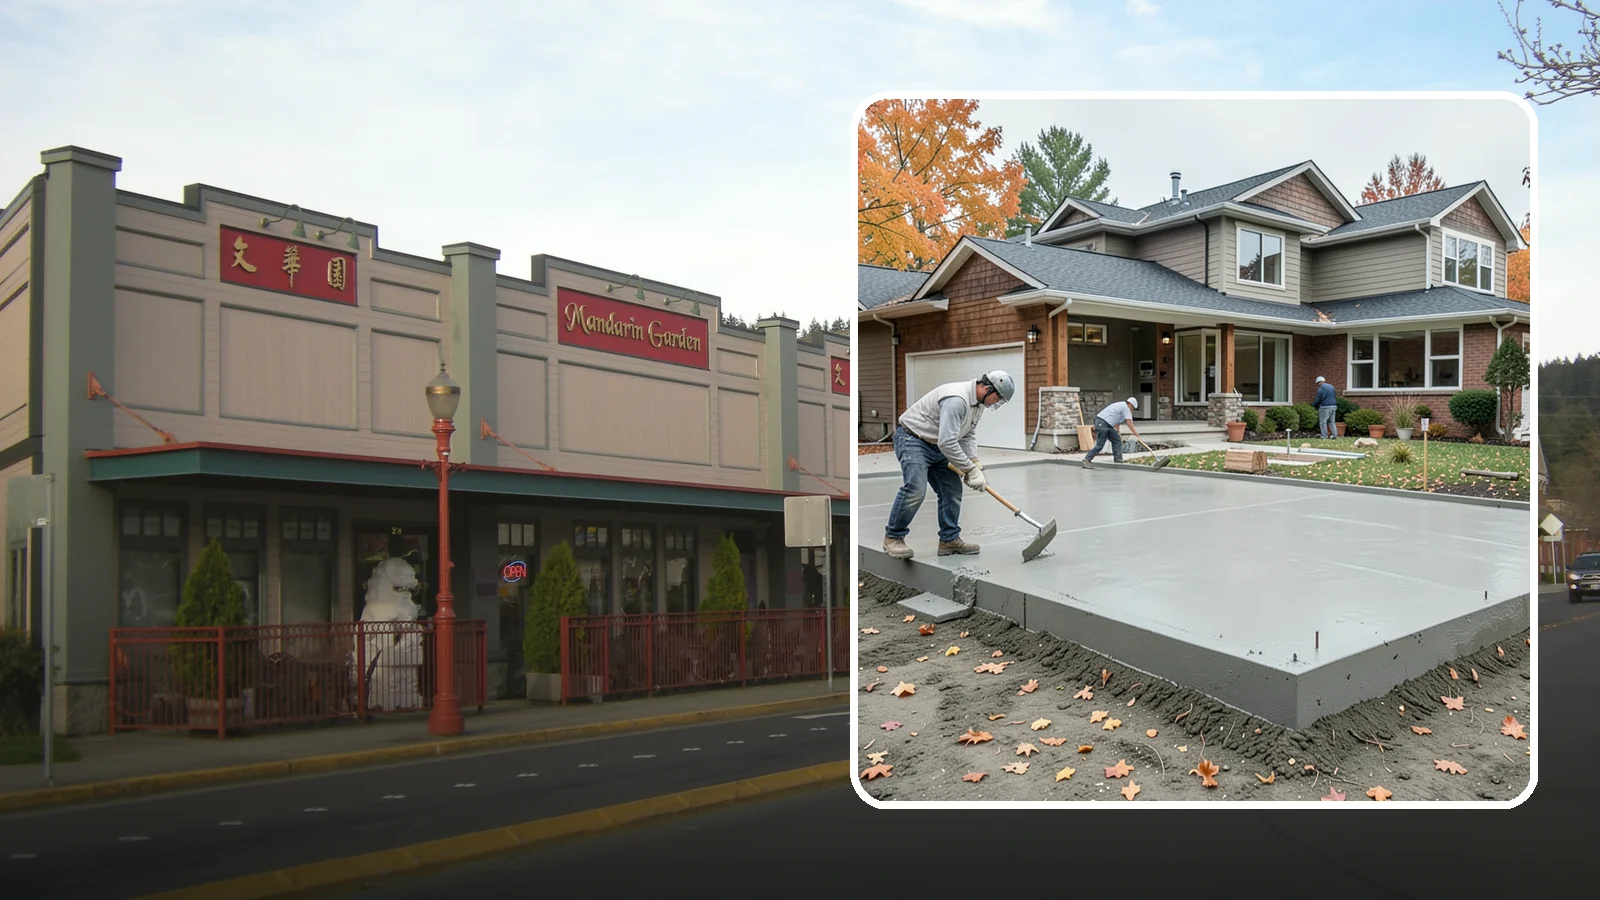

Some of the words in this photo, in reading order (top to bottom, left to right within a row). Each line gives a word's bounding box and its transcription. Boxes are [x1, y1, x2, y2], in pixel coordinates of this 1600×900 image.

[564, 302, 644, 341] Mandarin
[647, 320, 701, 352] Garden
[503, 565, 527, 578] OPEN
